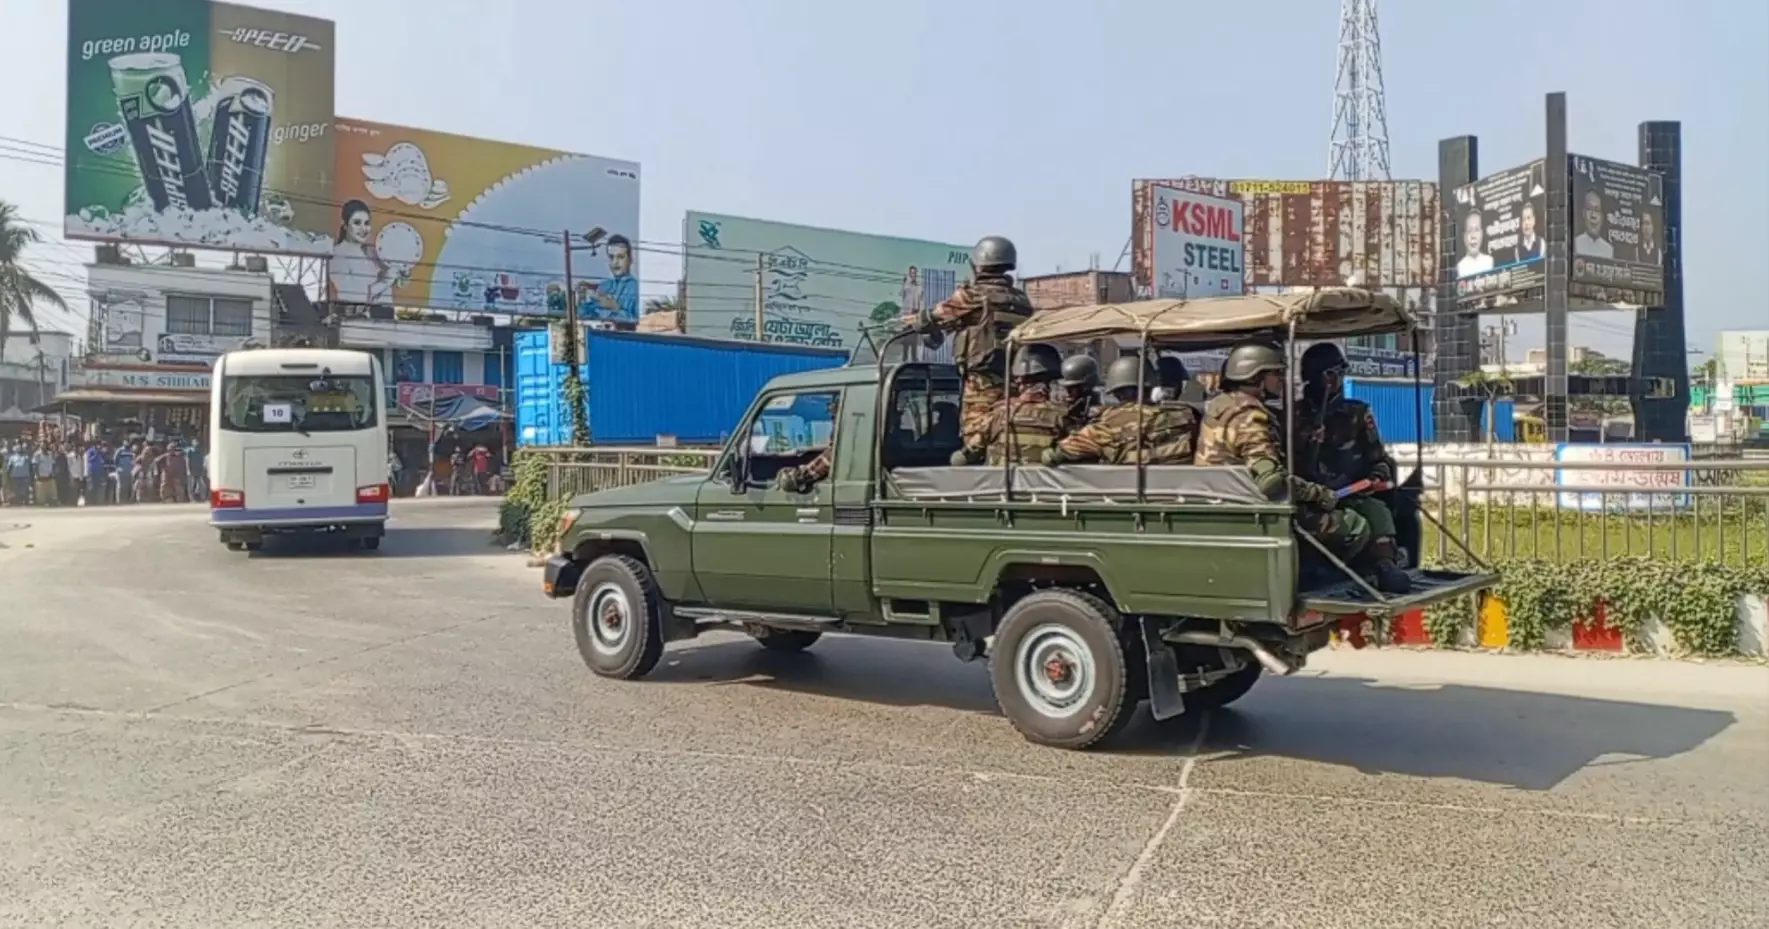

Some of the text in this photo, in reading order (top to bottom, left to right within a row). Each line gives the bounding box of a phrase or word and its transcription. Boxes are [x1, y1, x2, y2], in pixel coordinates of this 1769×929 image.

[82, 28, 191, 60] green apple
[218, 27, 322, 52] SPEED
[274, 120, 328, 145] ginger
[219, 112, 252, 206] SPEED
[1171, 198, 1241, 243] KSML
[947, 250, 969, 265] PHP
[1183, 241, 1241, 273] STEEL
[271, 408, 285, 418] 10
